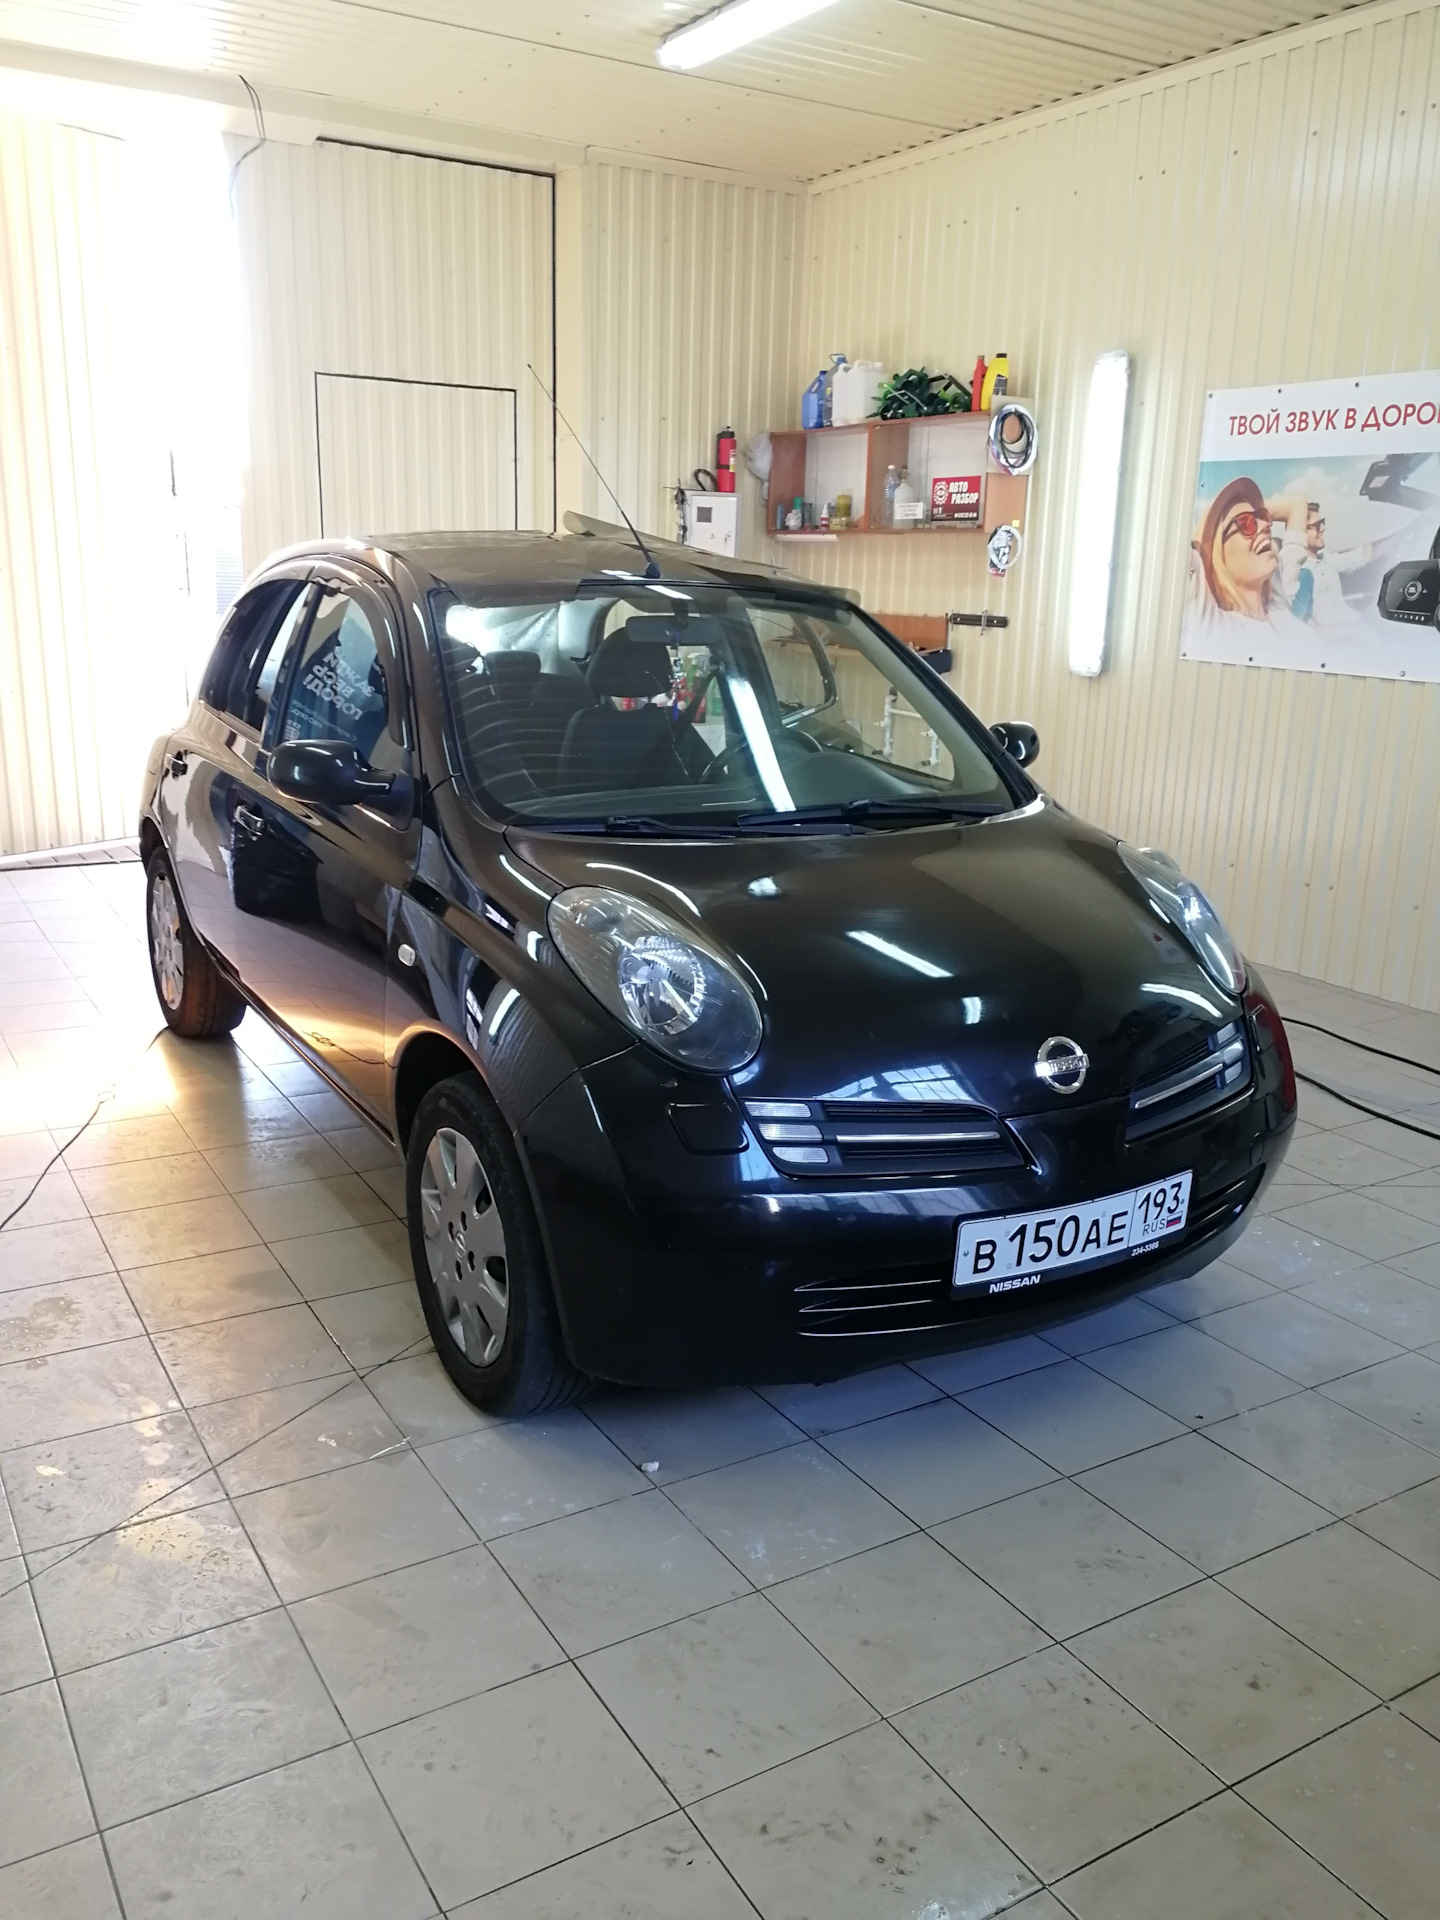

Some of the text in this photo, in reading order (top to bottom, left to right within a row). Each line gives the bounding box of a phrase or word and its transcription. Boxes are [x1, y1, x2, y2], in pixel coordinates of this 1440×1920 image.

[1229, 401, 1440, 436] ТВОЙ ЗВУК В ДОРО
[948, 480, 969, 493] АВТО
[1137, 1181, 1183, 1223] 193
[1142, 1218, 1166, 1237] RUS
[988, 1274, 1041, 1294] NISSAN
